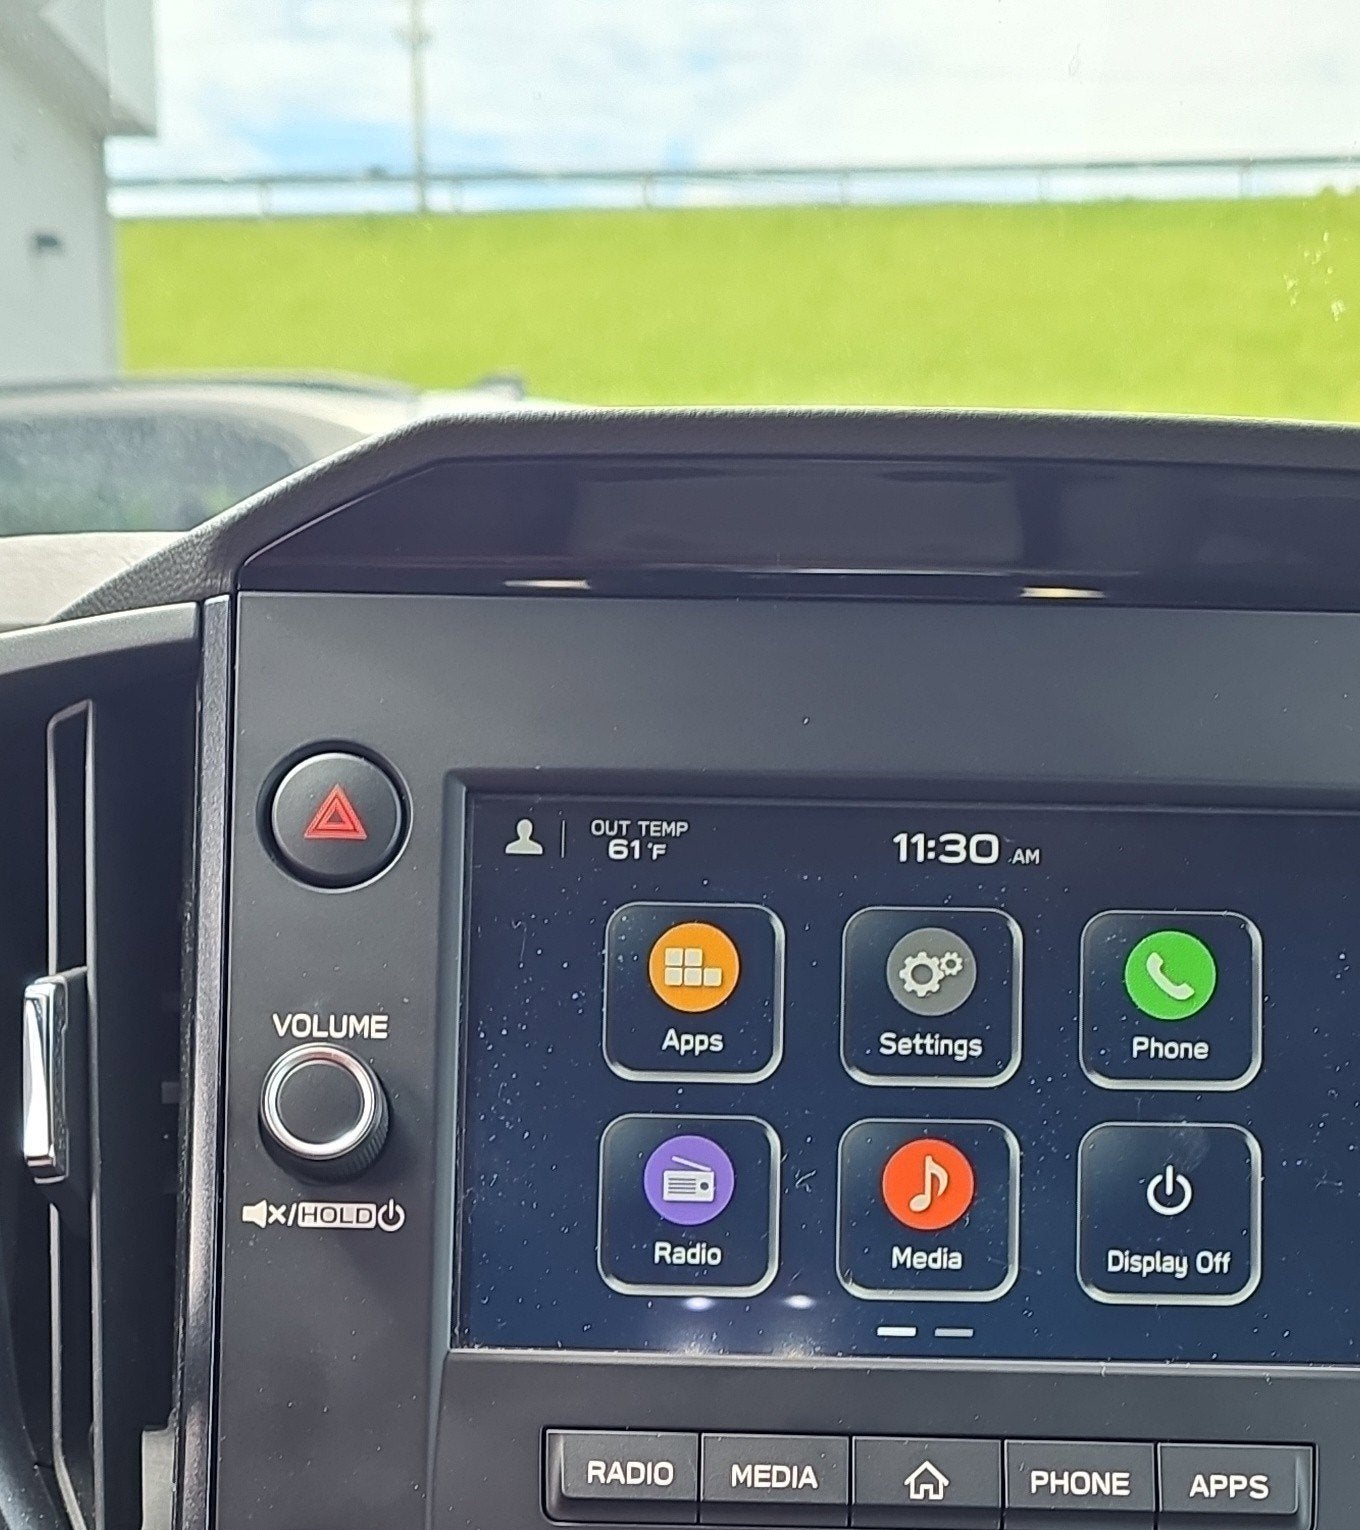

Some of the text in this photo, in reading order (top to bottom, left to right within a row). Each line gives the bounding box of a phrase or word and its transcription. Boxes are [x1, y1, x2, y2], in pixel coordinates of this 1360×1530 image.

[590, 819, 689, 837] OUT TEMP
[608, 838, 640, 860] 61
[892, 833, 1040, 865] 11:30 AM
[272, 1013, 389, 1039] VOLUME
[661, 1027, 724, 1056] Apps
[879, 1031, 983, 1062] Settings
[1132, 1036, 1209, 1060] Phone
[301, 1206, 372, 1225] HOLD
[654, 1241, 722, 1266] Radio
[891, 1246, 962, 1270] Media
[1107, 1249, 1231, 1279] Display Off
[587, 1460, 674, 1486] RADIO
[731, 1464, 818, 1489] MEDIA
[1030, 1470, 1131, 1496] PHONE
[1189, 1474, 1269, 1500] APPS
